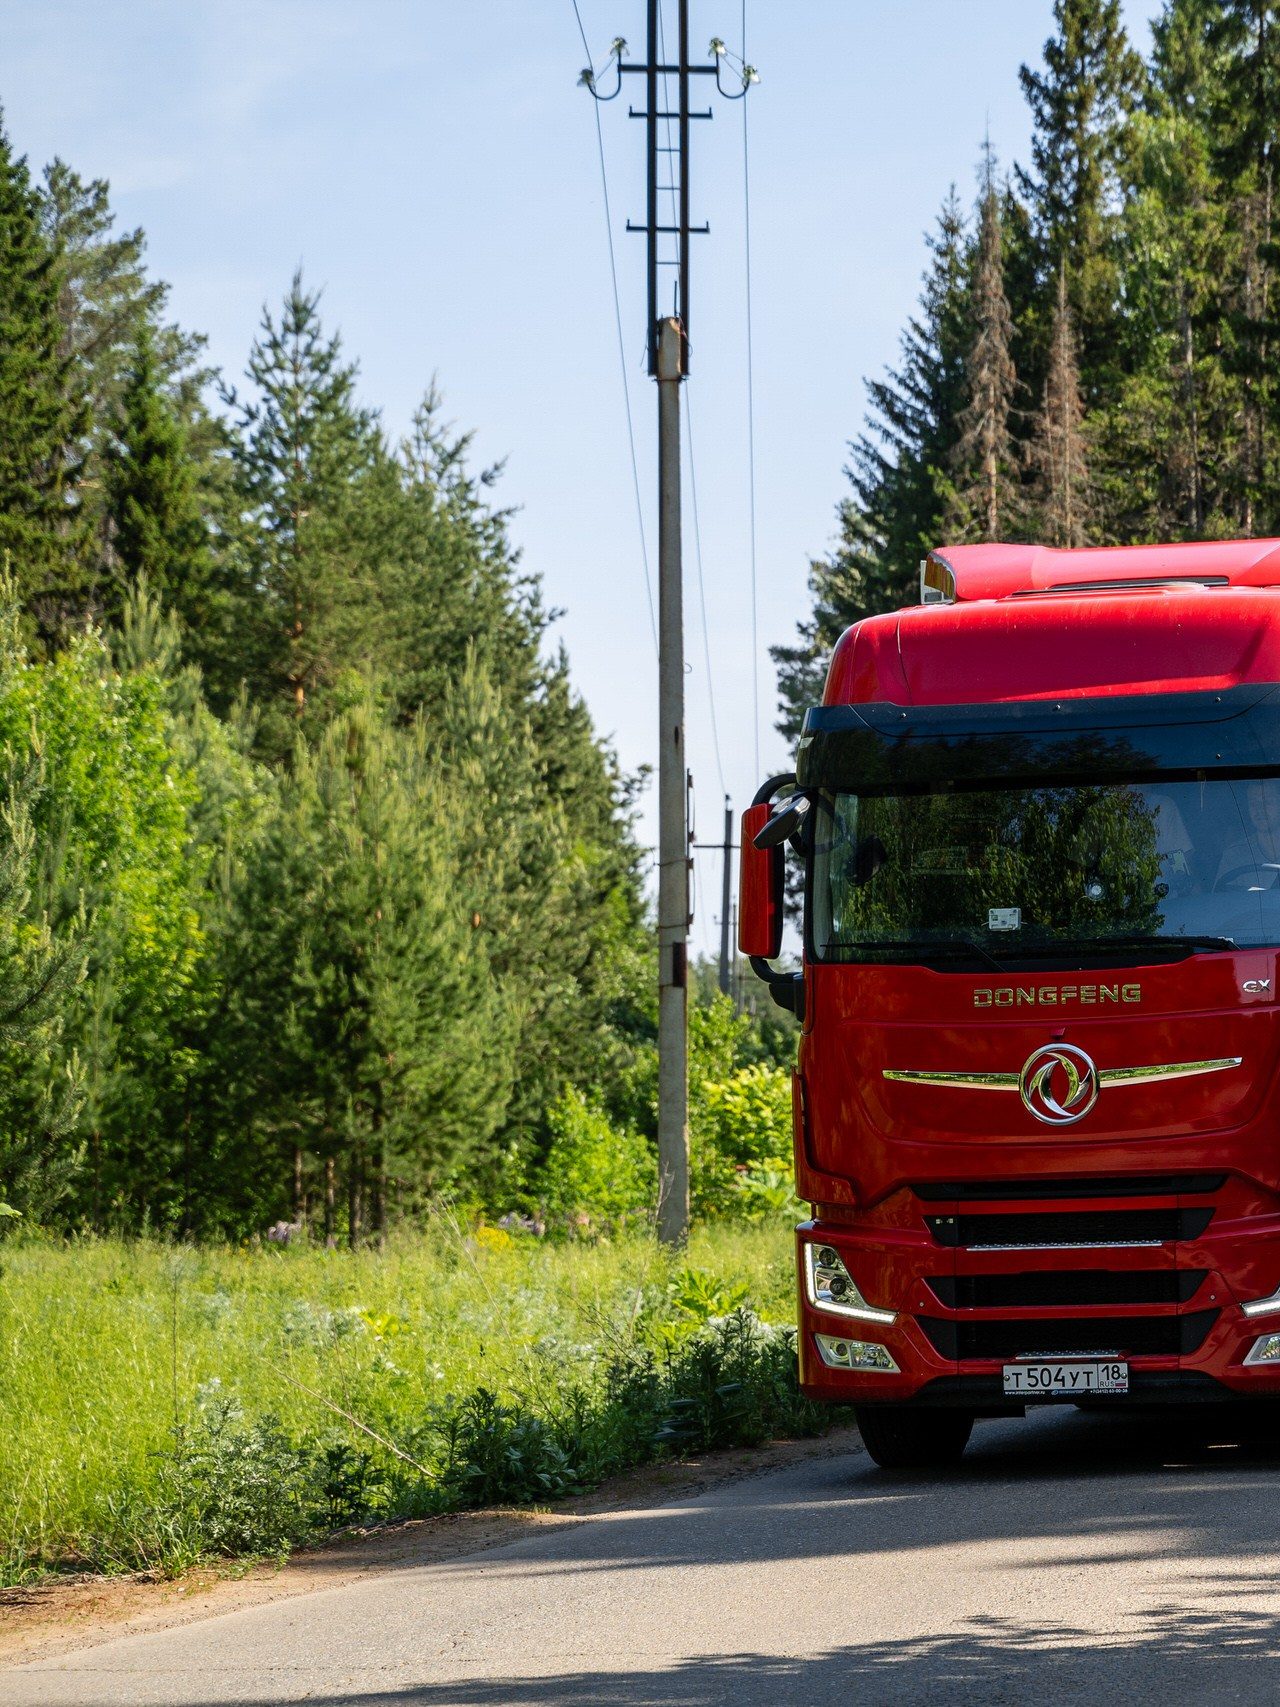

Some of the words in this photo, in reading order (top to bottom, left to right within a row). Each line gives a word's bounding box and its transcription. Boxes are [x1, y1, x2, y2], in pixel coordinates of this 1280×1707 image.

[1242, 978, 1271, 993] GX
[973, 983, 1141, 1008] DONGFENG
[1101, 1364, 1121, 1381] 18
